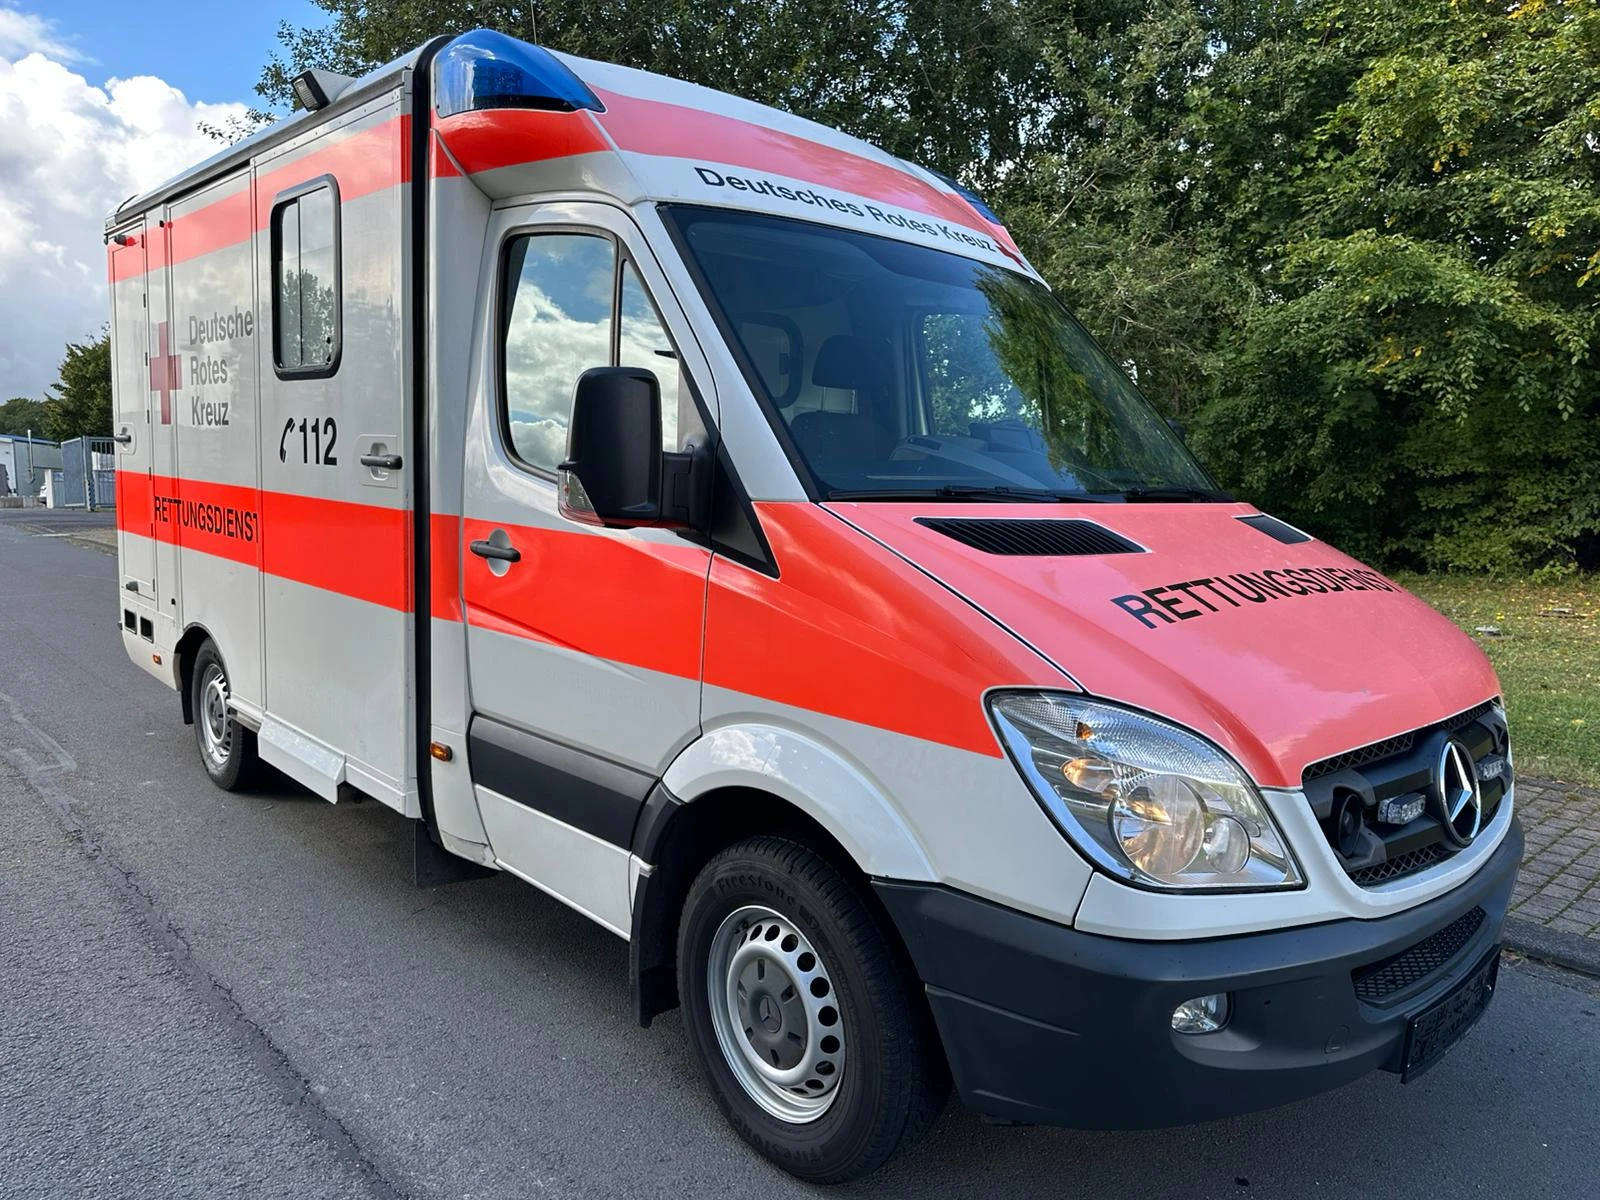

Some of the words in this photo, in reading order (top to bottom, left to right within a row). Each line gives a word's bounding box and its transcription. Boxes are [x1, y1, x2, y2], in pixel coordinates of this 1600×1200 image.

[693, 166, 863, 217] Deutsches
[864, 204, 942, 236] Rotes
[936, 223, 997, 252] Kreuz
[190, 355, 228, 385] Rotes
[192, 396, 229, 426] Kreuz
[299, 417, 338, 466] 112
[1110, 568, 1402, 629] RETTUNGSDIENST
